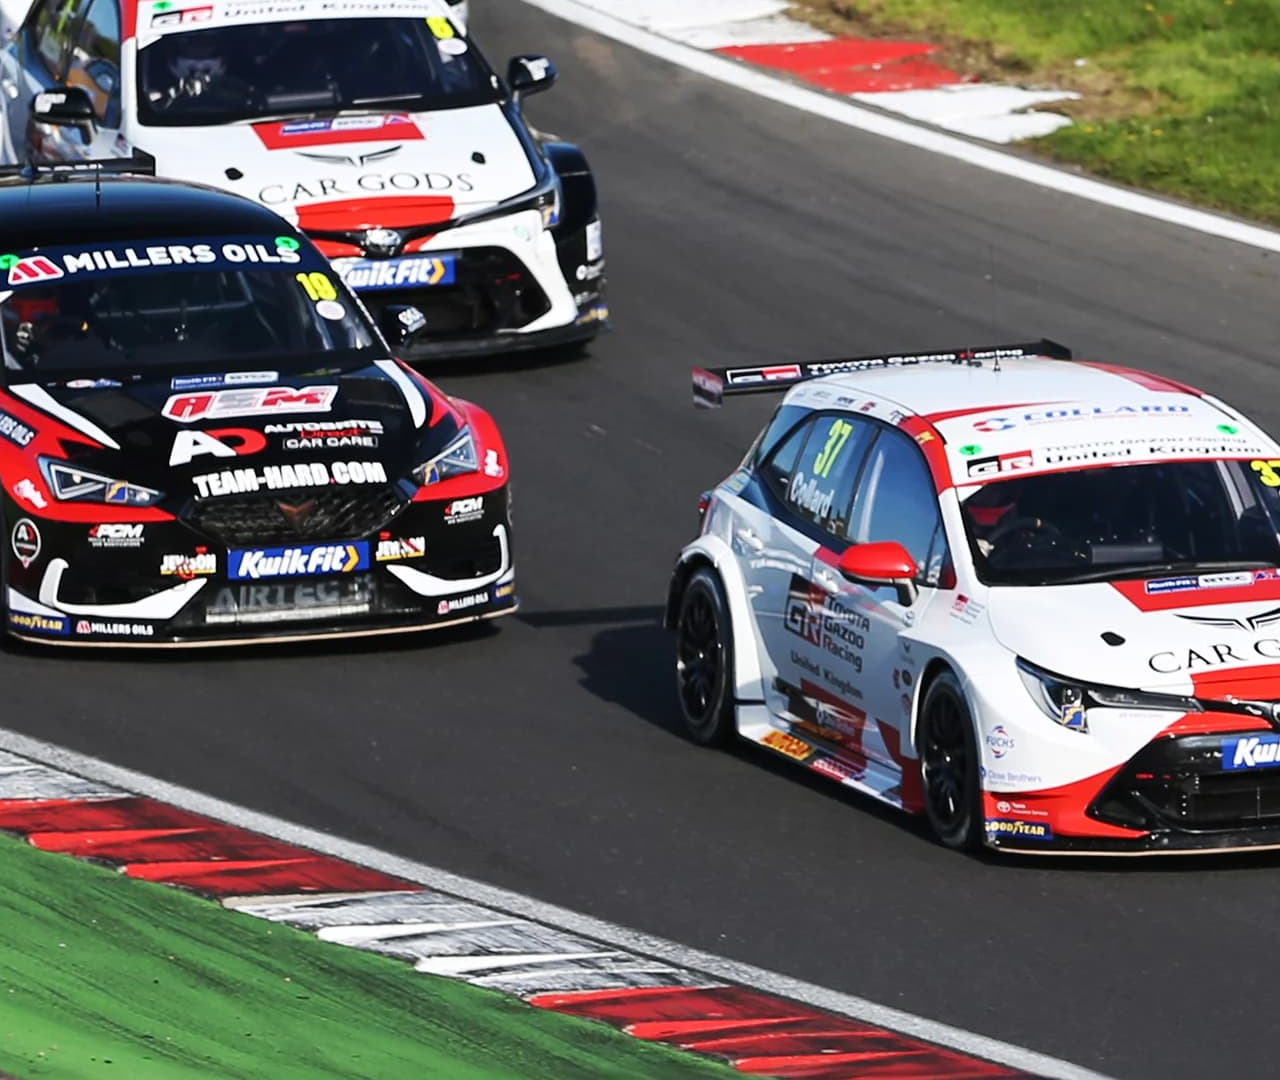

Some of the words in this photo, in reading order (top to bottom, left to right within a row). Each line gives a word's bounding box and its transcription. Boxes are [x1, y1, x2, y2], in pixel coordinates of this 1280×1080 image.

[258, 179, 347, 204] CAR
[357, 172, 474, 195] GODS
[63, 245, 217, 273] MILLERS
[221, 244, 302, 264] OILS
[296, 273, 337, 302] 19
[264, 420, 384, 434] AUTOBRITE
[1023, 405, 1190, 421] COLLARD
[11, 424, 35, 446] OILS
[286, 438, 323, 449] CAR
[327, 436, 376, 448] CARE
[812, 419, 852, 478] 37
[1045, 448, 1132, 464] United
[1149, 441, 1263, 457] Kingdom
[193, 462, 388, 498] TEAM-HARD.COM
[791, 472, 835, 516] Collard
[238, 544, 347, 577] KwikFit
[213, 581, 339, 608] AIRTEC
[827, 595, 870, 633] TOYOTA
[91, 623, 130, 634] MILLERS
[132, 624, 154, 636] OILS
[823, 615, 865, 650] GAZOO
[823, 635, 863, 673] Racing
[1148, 643, 1249, 673] CAR
[986, 734, 1015, 749] FUCHS
[984, 821, 1045, 837] GOODYEAR
